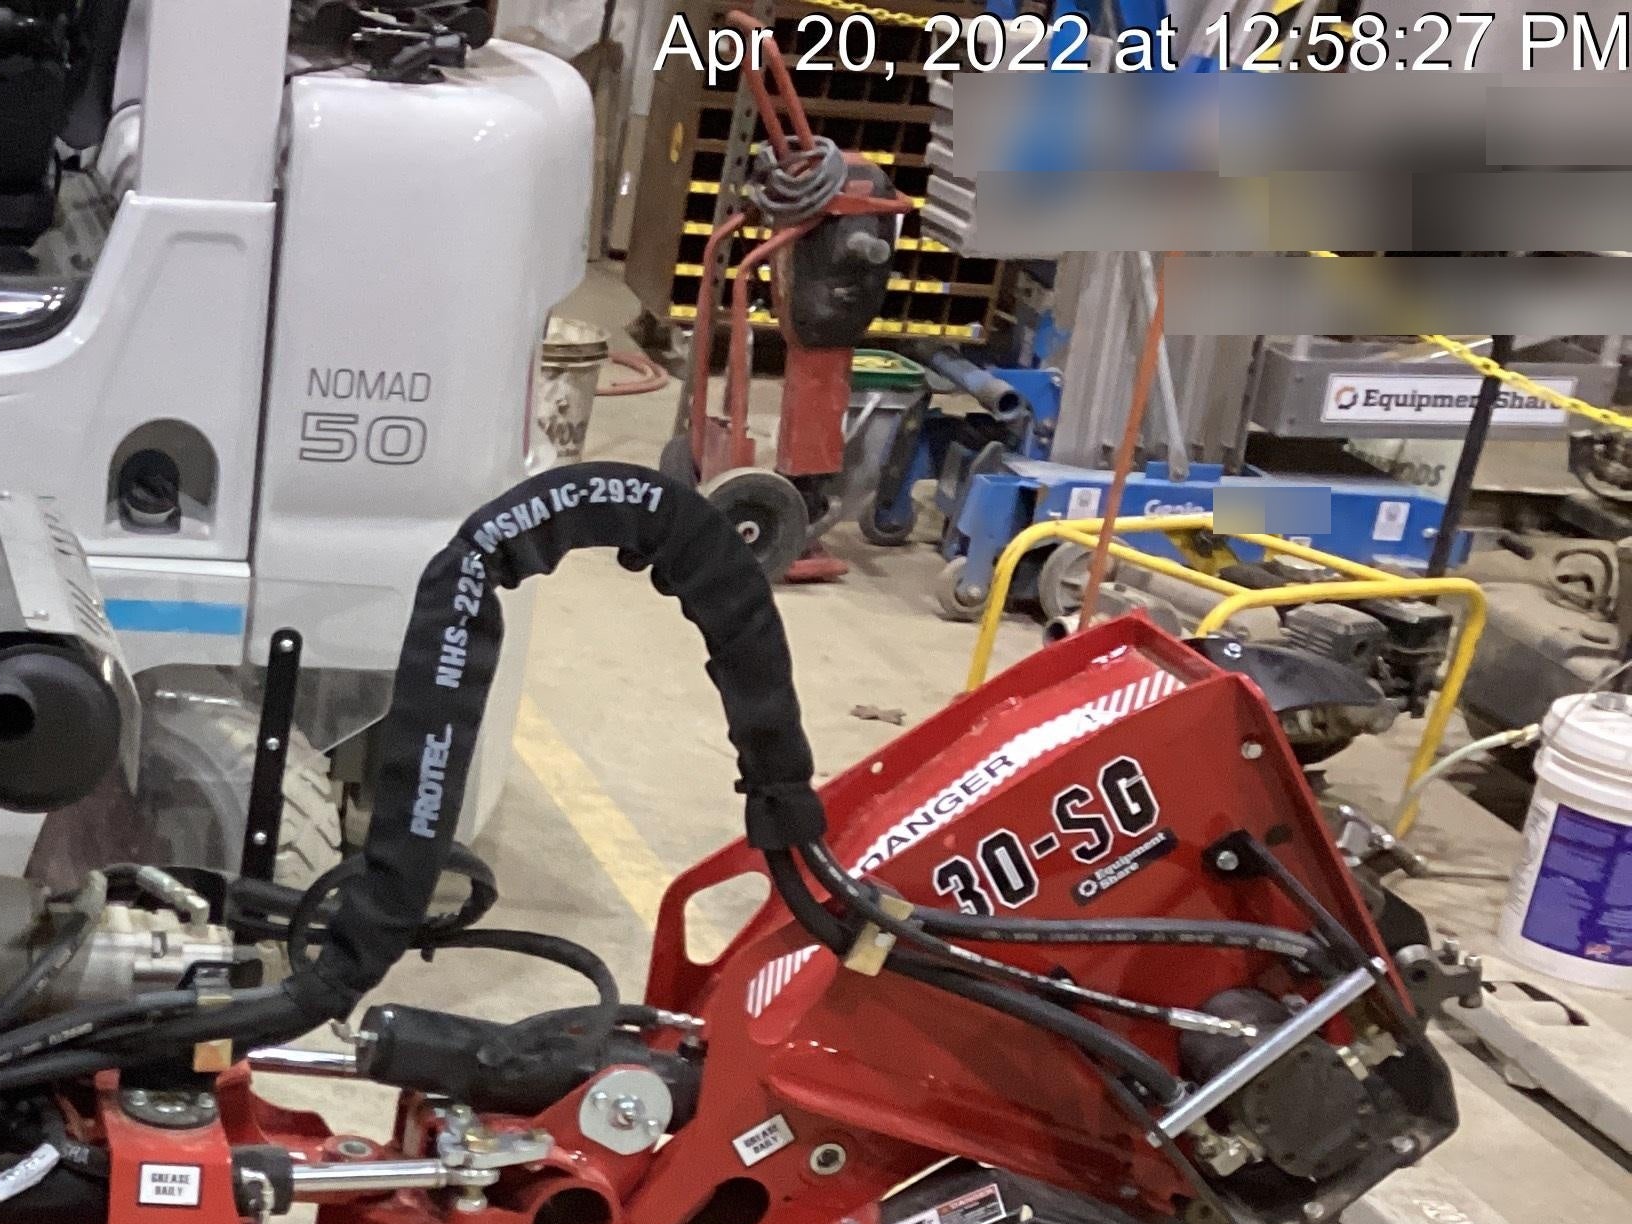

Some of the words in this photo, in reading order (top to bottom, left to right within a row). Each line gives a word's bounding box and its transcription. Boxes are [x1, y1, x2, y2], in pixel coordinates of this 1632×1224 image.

[308, 367, 431, 402] NOMAD
[1362, 388, 1481, 412] Equipmen
[299, 411, 428, 466] 50
[472, 496, 551, 554] MSHA
[860, 755, 1015, 873] DANGER
[933, 755, 1160, 917] 30-SG
[1094, 831, 1167, 881] Equipment
[1099, 862, 1140, 890] Share
[151, 1172, 191, 1185] GREASE
